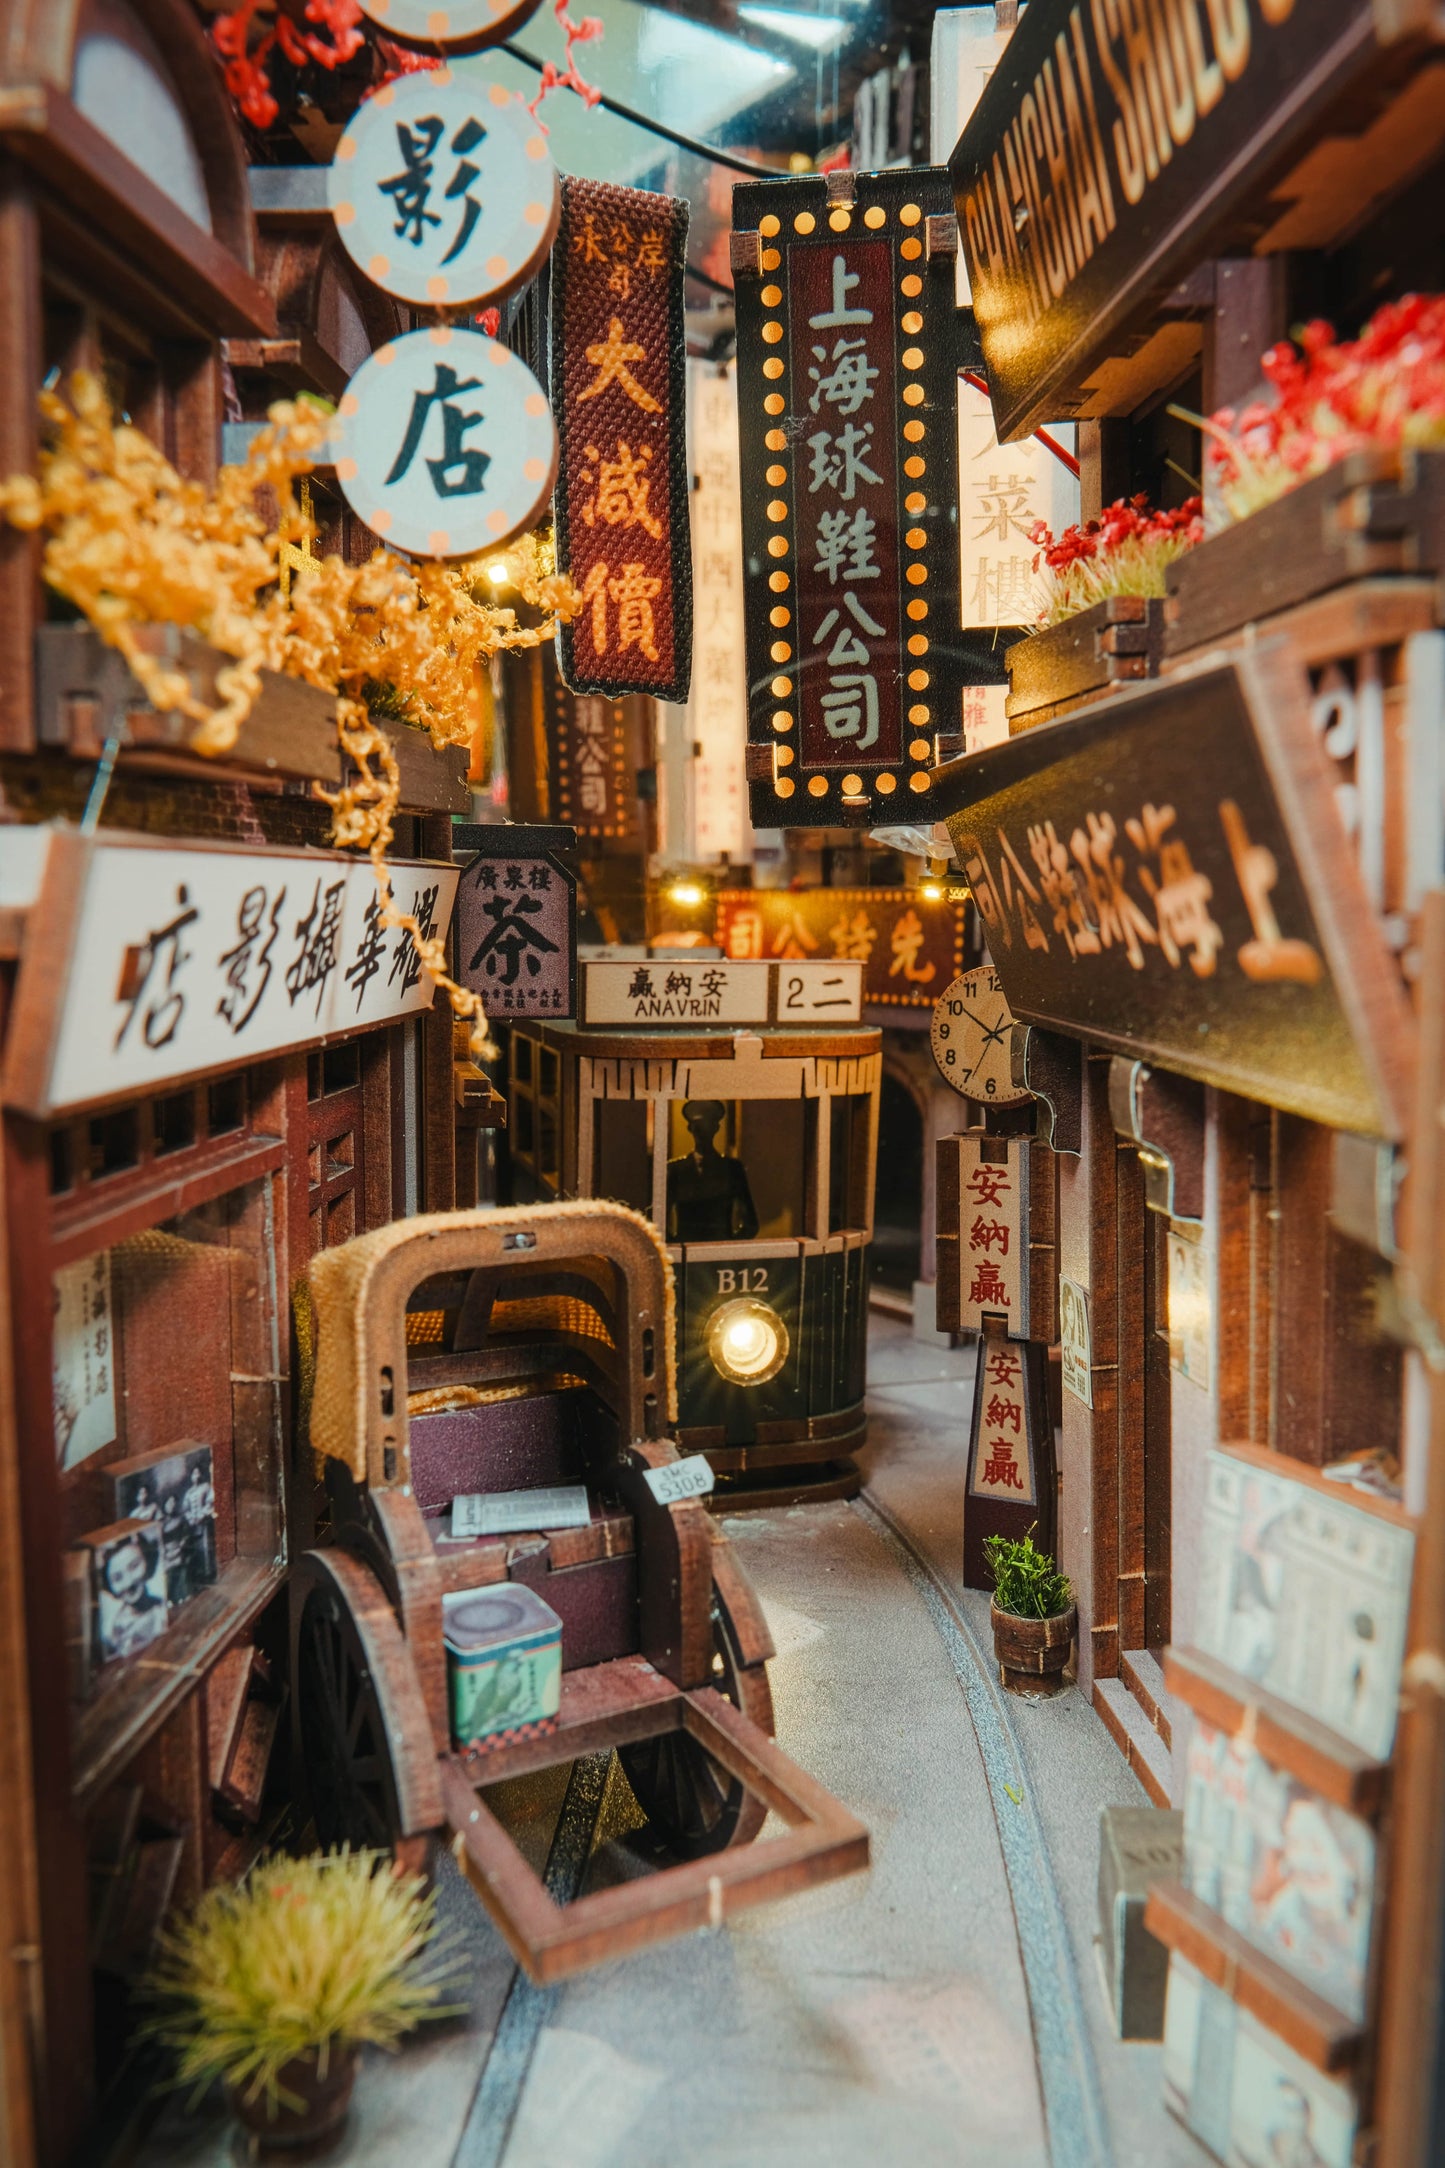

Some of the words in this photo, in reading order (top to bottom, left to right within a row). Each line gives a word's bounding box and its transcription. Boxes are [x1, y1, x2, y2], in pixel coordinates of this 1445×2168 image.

[377, 115, 488, 267] 影
[384, 362, 491, 499] 店
[576, 316, 666, 663] 大減價
[806, 255, 886, 751] 上海球鞋公司
[469, 893, 561, 987] 茶
[786, 978, 805, 1009] 2
[964, 982, 978, 998] 11
[634, 999, 721, 1018] ANAVRIN
[947, 999, 964, 1017] 10
[939, 1023, 951, 1040] 9
[945, 1049, 956, 1066] 8
[962, 1068, 973, 1084] 7
[985, 1077, 997, 1095] 6
[716, 1267, 769, 1295] B12
